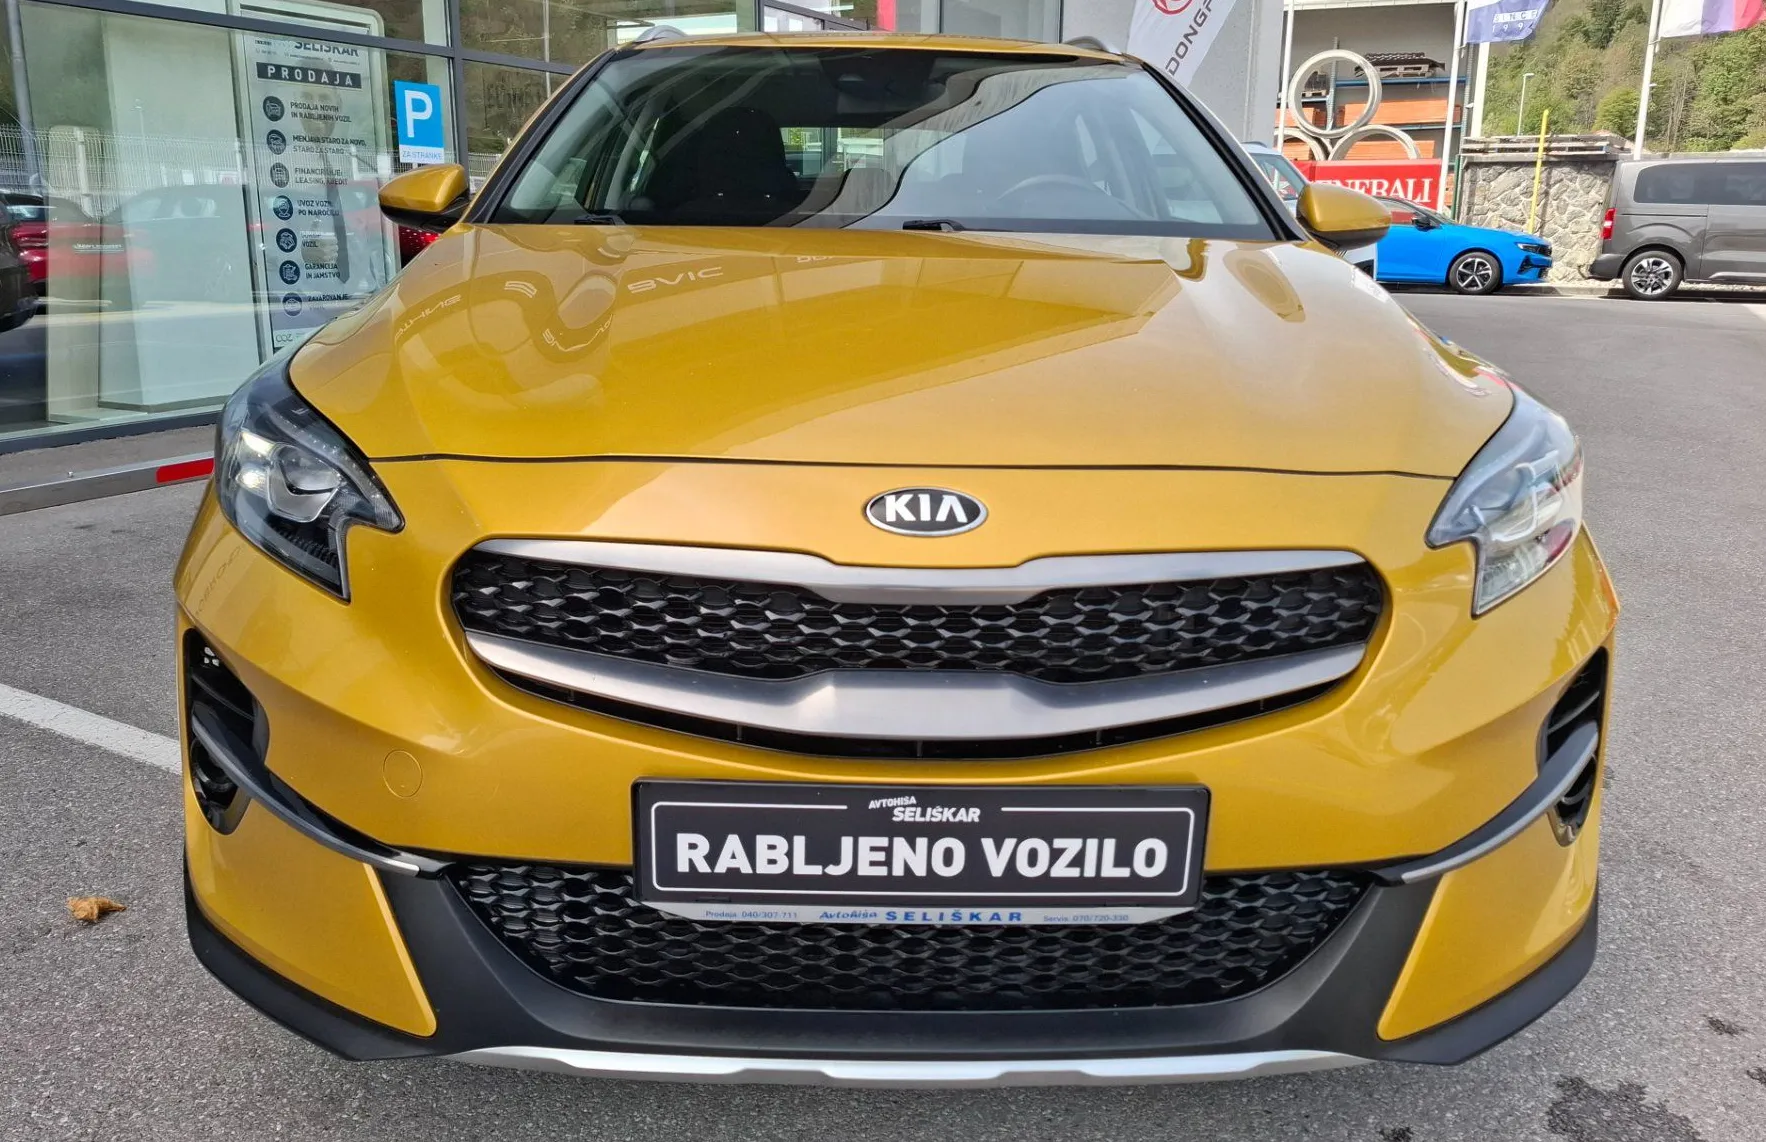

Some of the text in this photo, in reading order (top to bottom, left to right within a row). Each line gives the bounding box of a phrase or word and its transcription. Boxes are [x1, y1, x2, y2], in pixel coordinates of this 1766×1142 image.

[267, 65, 353, 86] PRODAJA
[290, 102, 339, 112] PRODAJA NOVIH
[299, 112, 334, 121] RABLJENIH
[404, 90, 433, 138] P
[321, 136, 341, 145] STARO
[293, 145, 315, 153] STARO
[324, 147, 345, 155] STARO
[412, 151, 441, 160] STRANKE
[884, 493, 969, 523] KIA
[892, 805, 981, 822] SELIŠKAR
[676, 833, 1168, 878] RABLJENO VOZILO
[885, 909, 1022, 922] SELIŠKAR
